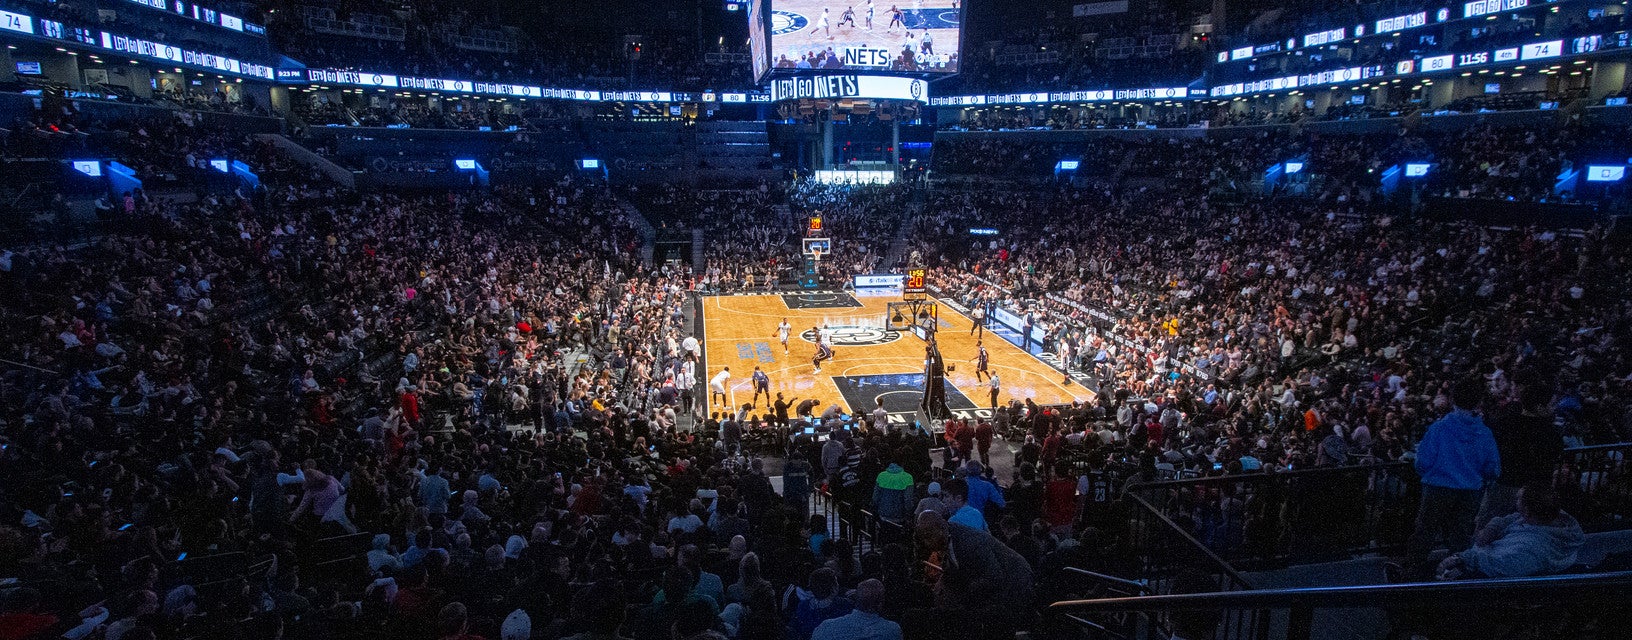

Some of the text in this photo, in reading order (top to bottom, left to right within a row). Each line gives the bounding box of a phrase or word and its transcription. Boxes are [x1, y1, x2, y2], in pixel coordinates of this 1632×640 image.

[5, 14, 21, 28] 74
[1534, 45, 1549, 56] 74
[845, 48, 888, 66] NETS
[1459, 52, 1488, 66] 11:56
[1432, 58, 1444, 69] 80
[327, 72, 337, 82] GO
[337, 71, 360, 83] NETS
[425, 78, 445, 90] NETS
[496, 84, 513, 94] NETS
[798, 79, 812, 97] GO
[817, 75, 857, 98] NETS
[623, 92, 641, 101] NETS
[750, 94, 769, 102] 11:56
[1137, 89, 1155, 99] NETS
[908, 276, 923, 288] 20
[1094, 487, 1106, 502] 23
